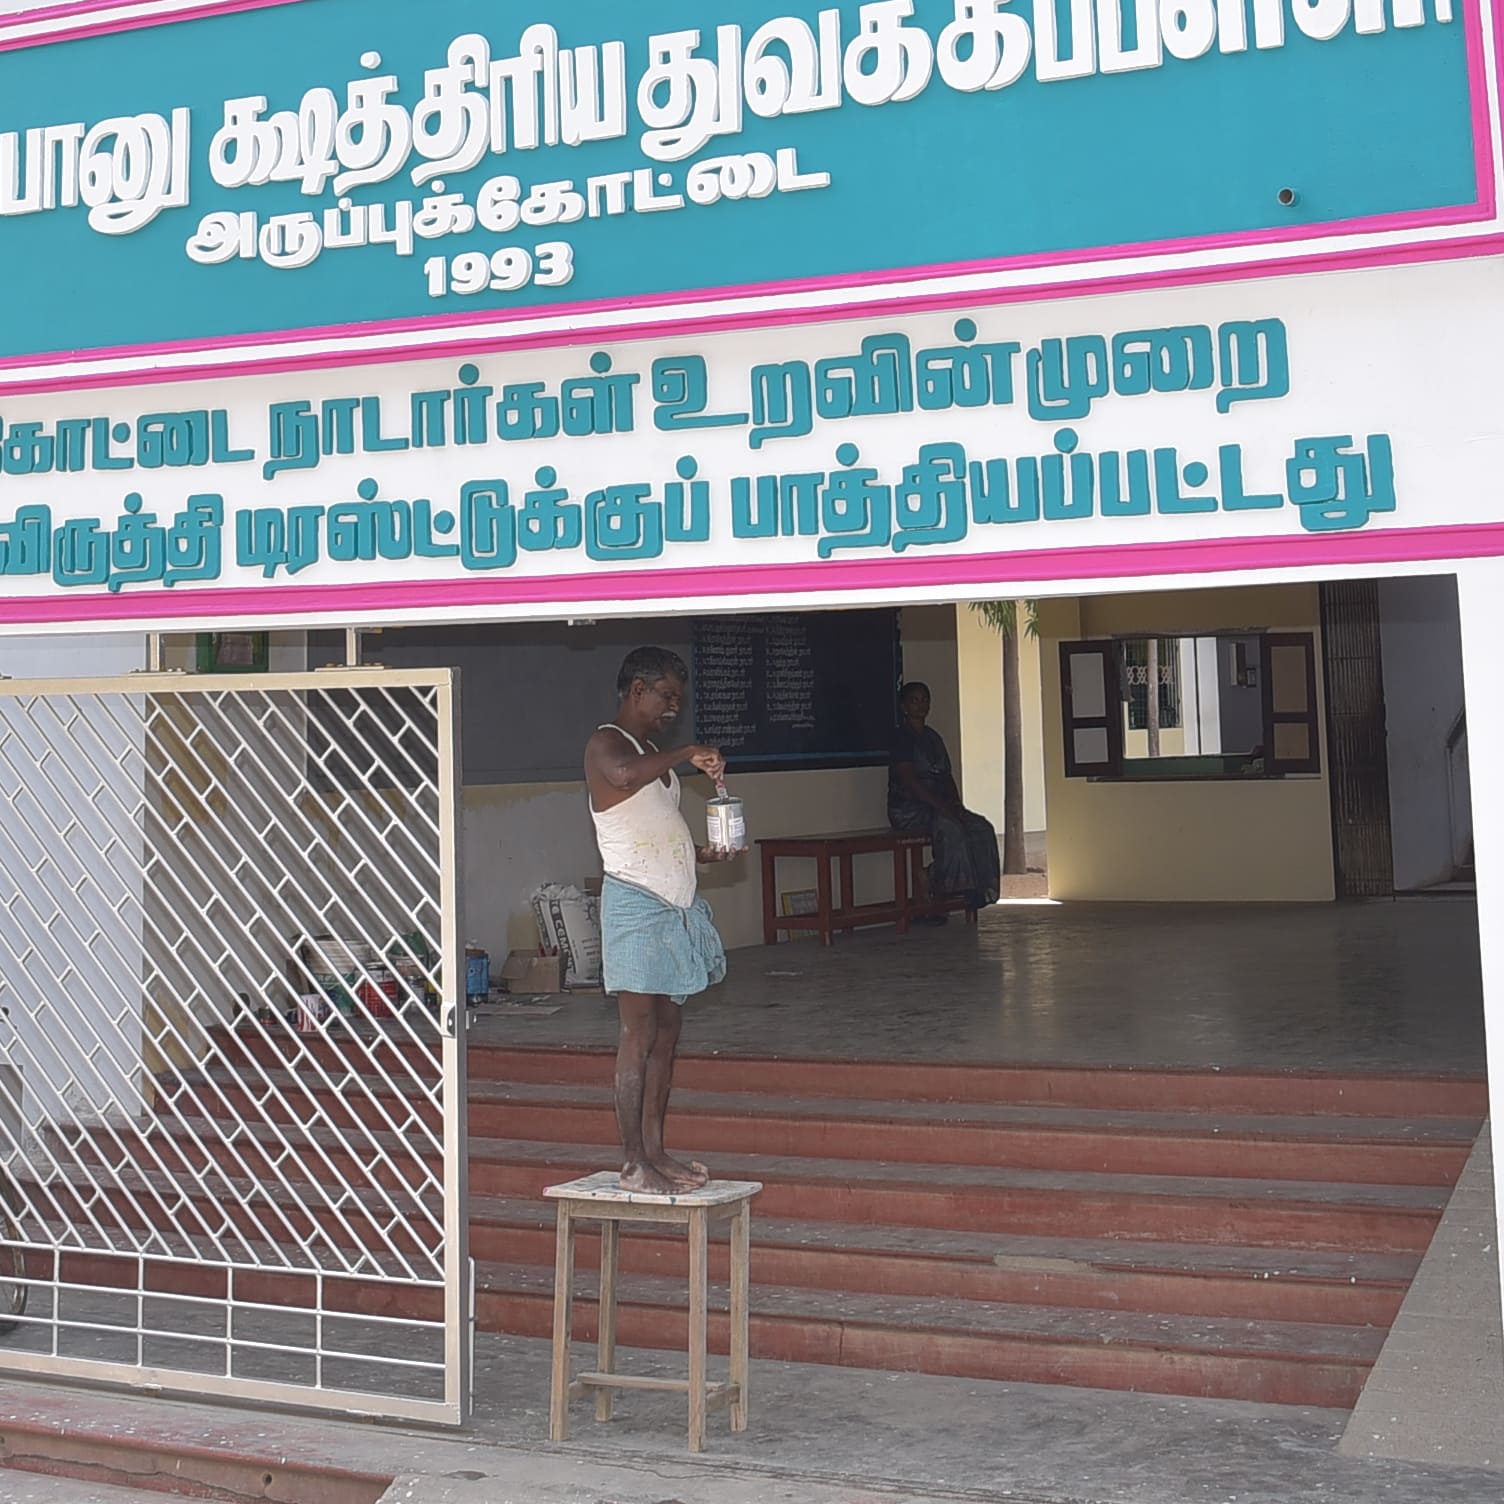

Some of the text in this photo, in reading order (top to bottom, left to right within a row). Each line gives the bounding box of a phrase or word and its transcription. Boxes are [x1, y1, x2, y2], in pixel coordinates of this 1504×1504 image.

[185, 146, 831, 268] அருப்புக்கோட்டை
[424, 242, 575, 297] 1993
[262, 361, 641, 481] நாடார்கள்
[235, 454, 711, 580] டிரஸ்ட்டுக்குப்
[729, 427, 1397, 560] பாத்தியப்பட்டது
